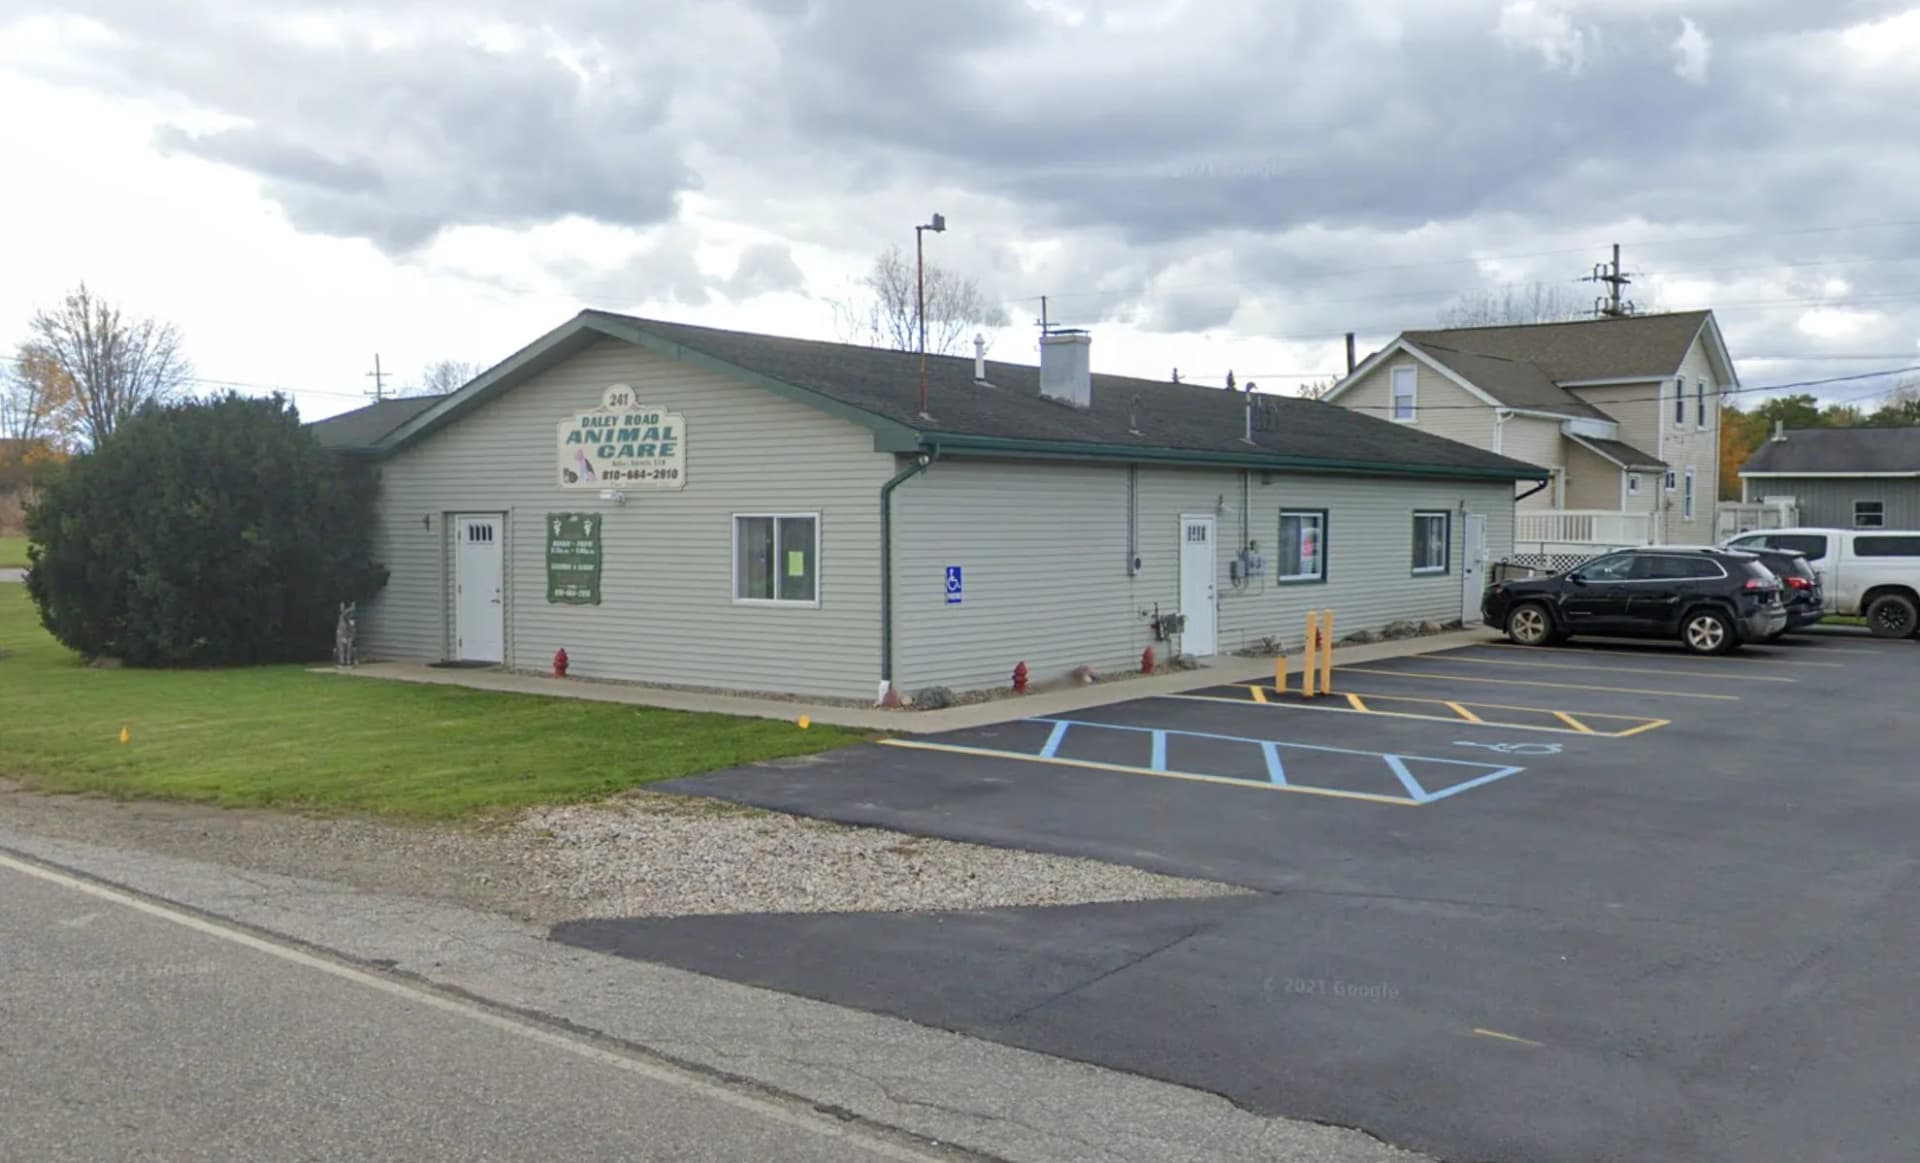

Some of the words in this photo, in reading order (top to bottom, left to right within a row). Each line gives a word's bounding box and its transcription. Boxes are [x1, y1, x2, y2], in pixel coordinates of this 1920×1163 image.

[609, 393, 629, 407] 241
[581, 415, 619, 428] DALEY
[624, 414, 659, 426] ROAD
[565, 426, 678, 444] ANIMAL
[597, 443, 677, 458] CARE
